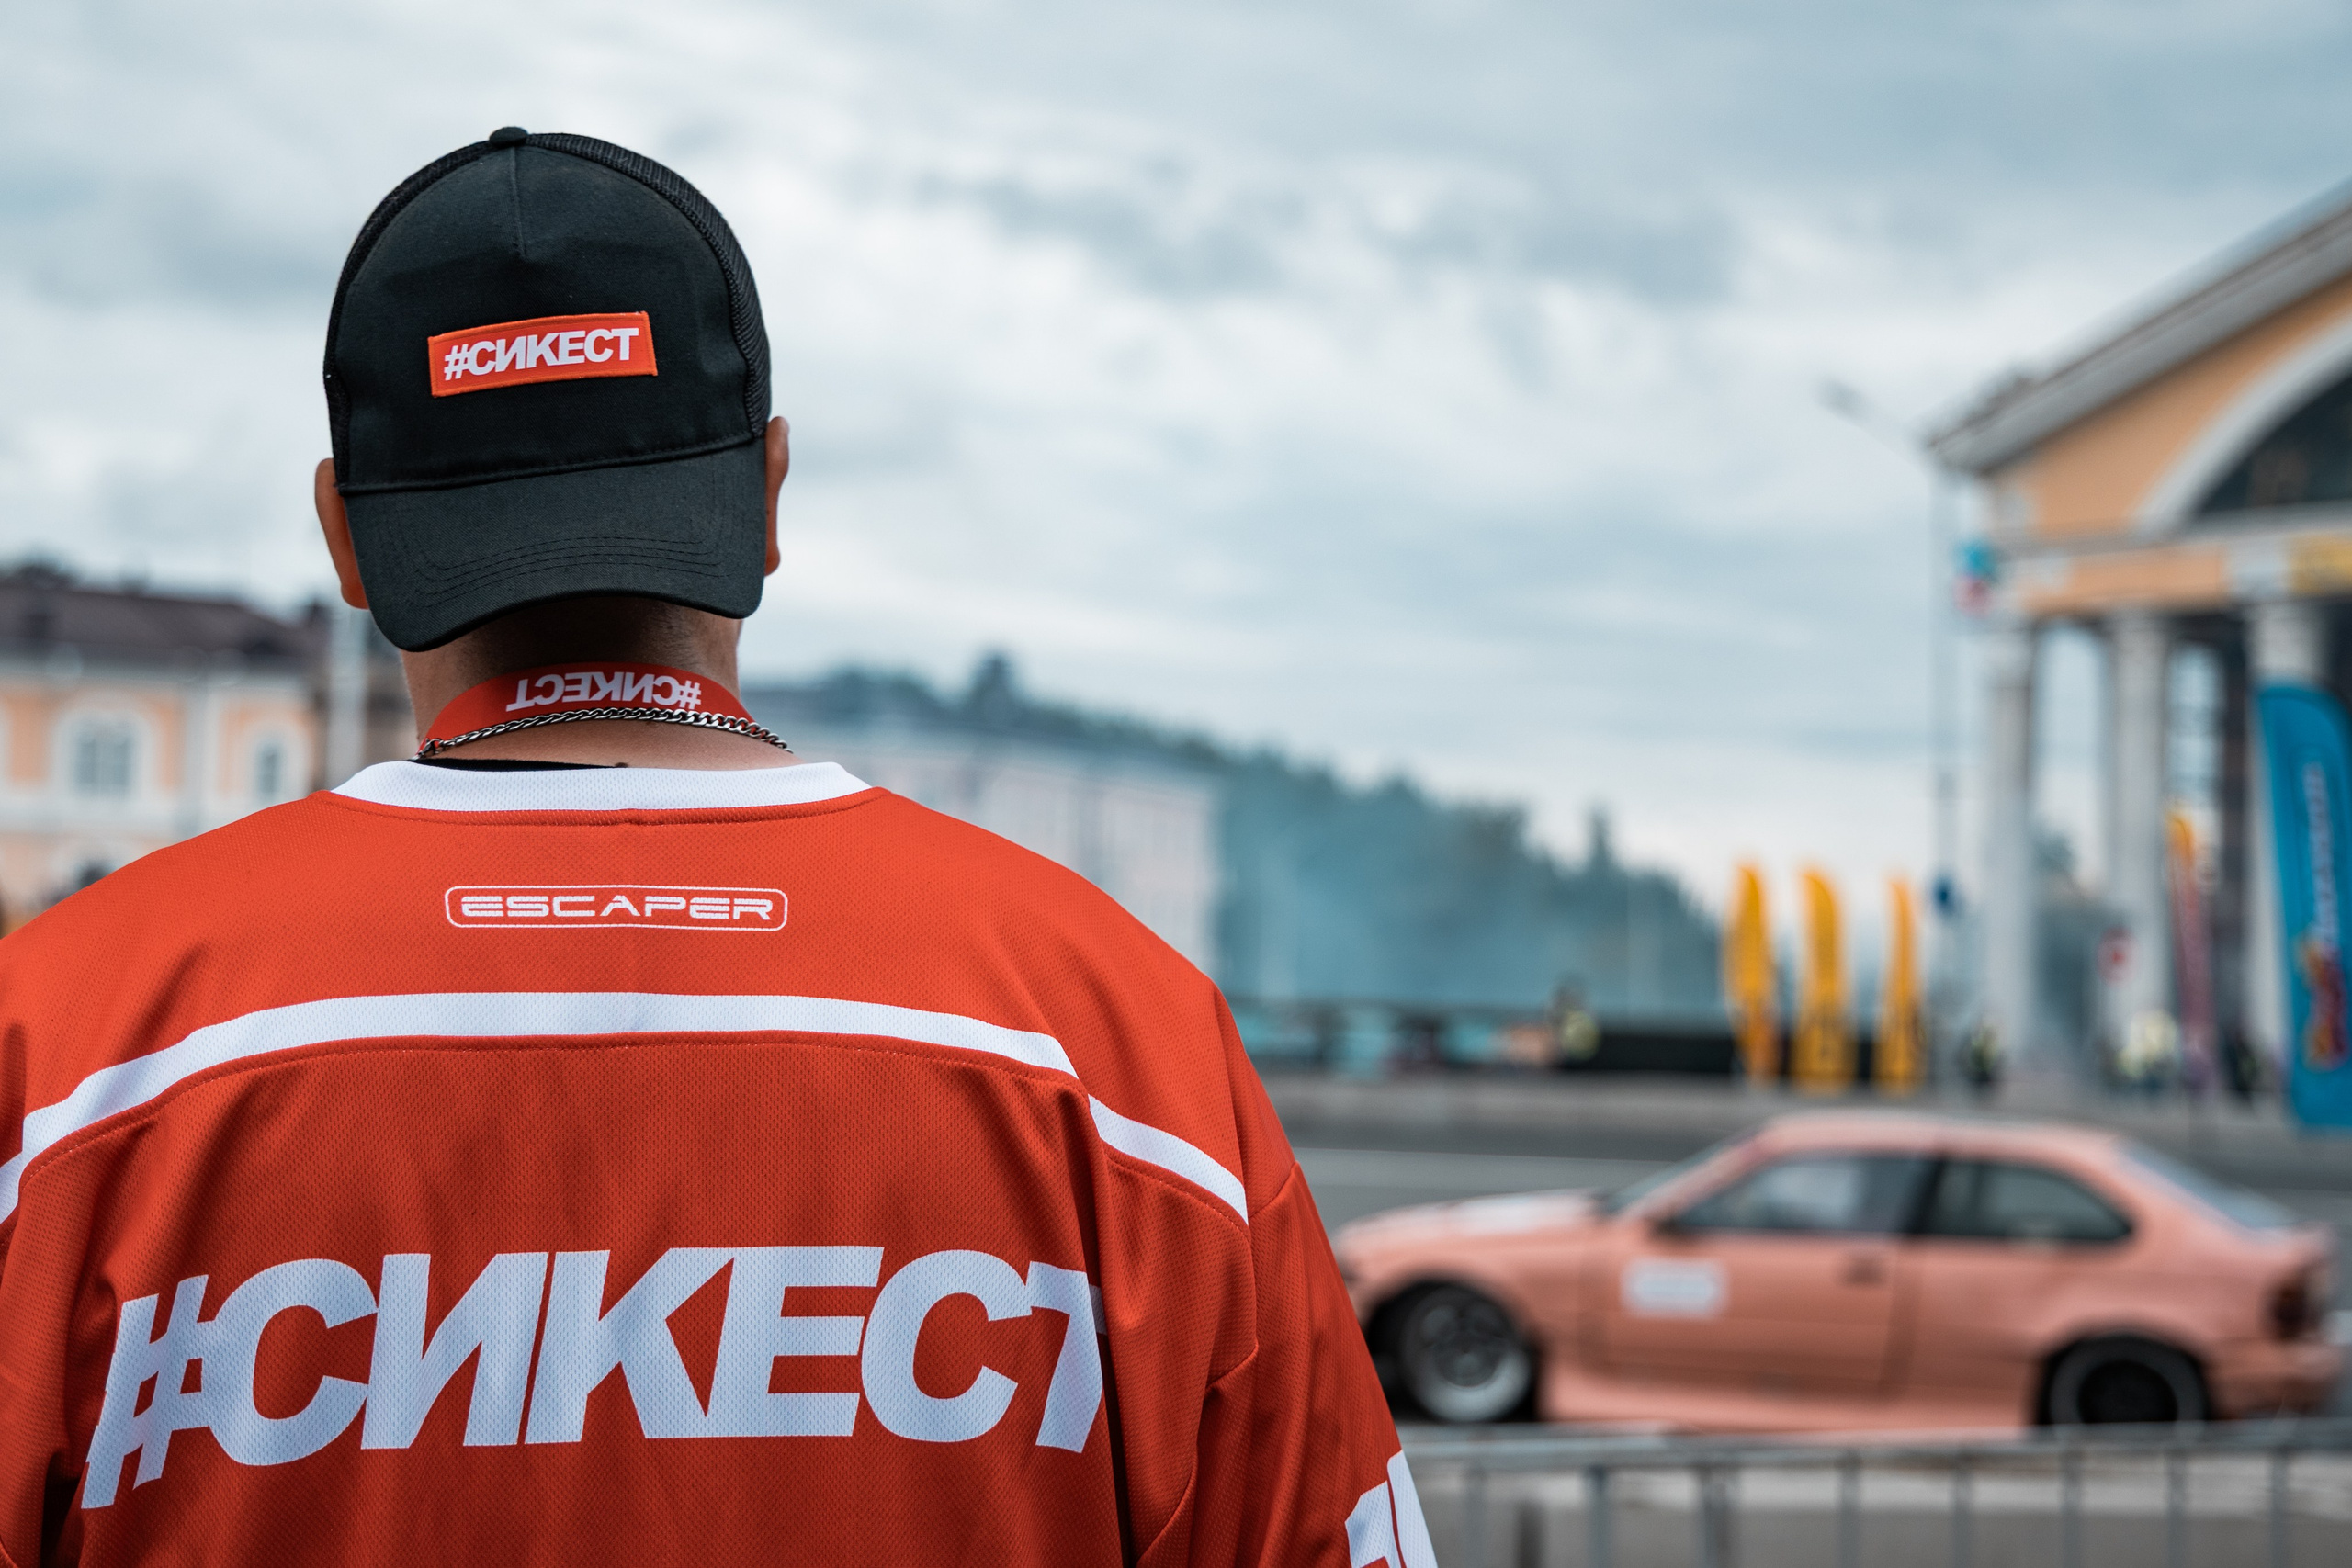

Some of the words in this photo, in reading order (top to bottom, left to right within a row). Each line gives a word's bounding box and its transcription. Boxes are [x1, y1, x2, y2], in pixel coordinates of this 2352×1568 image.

[444, 327, 639, 381] #СИКЕСТ
[505, 671, 701, 712] #СИКЕСТ
[460, 895, 774, 920] ESCAPER
[81, 1246, 1107, 1509] #СИКЕСТ
